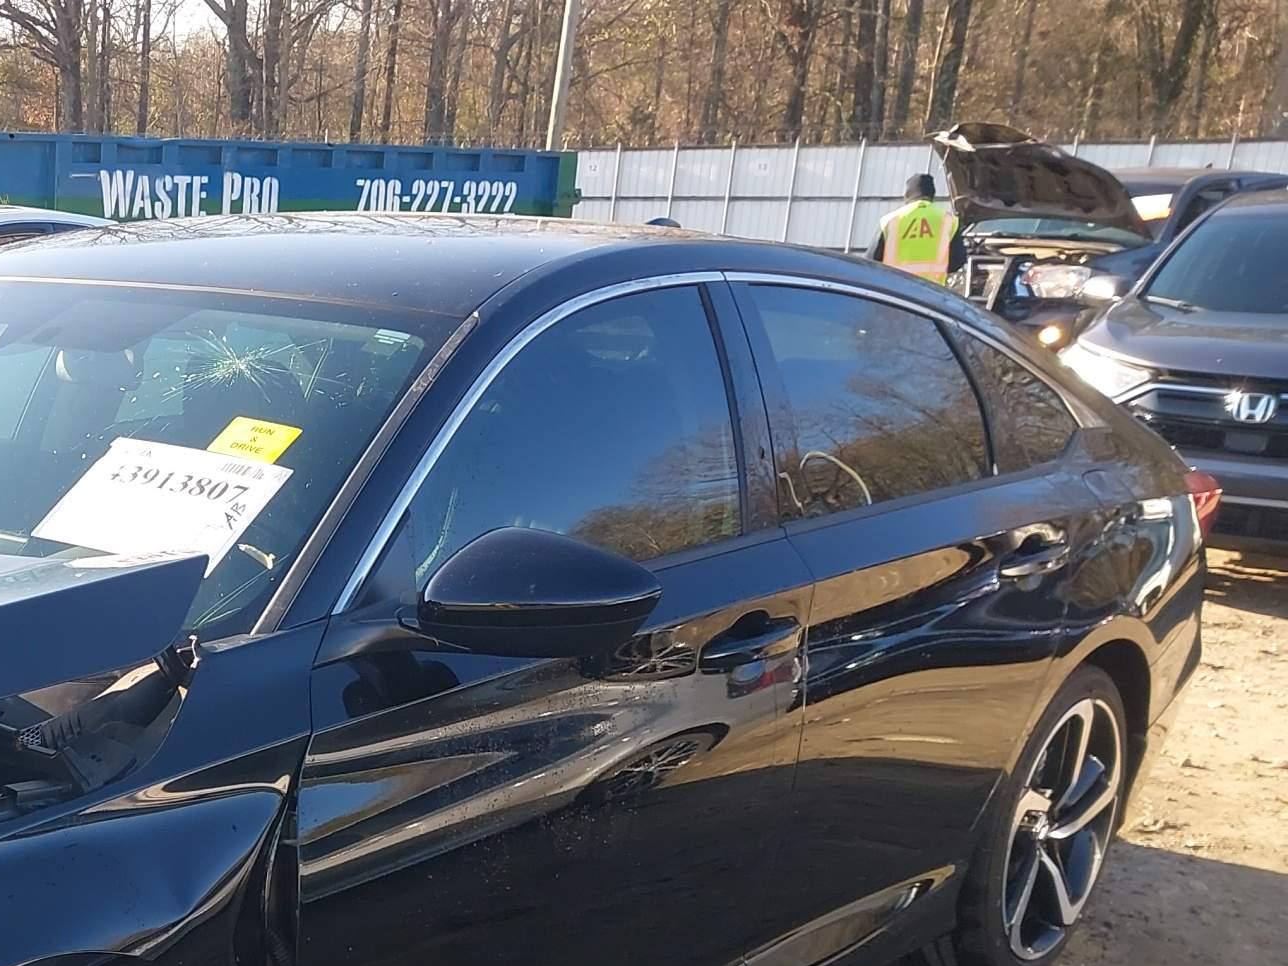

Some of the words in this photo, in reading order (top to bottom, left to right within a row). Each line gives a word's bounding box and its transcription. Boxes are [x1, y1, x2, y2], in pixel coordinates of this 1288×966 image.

[99, 169, 209, 220] WASTE
[221, 171, 280, 215] PRO
[356, 179, 518, 216] 706-227-3222
[250, 425, 275, 436] RUN
[229, 442, 264, 454] DRIVE
